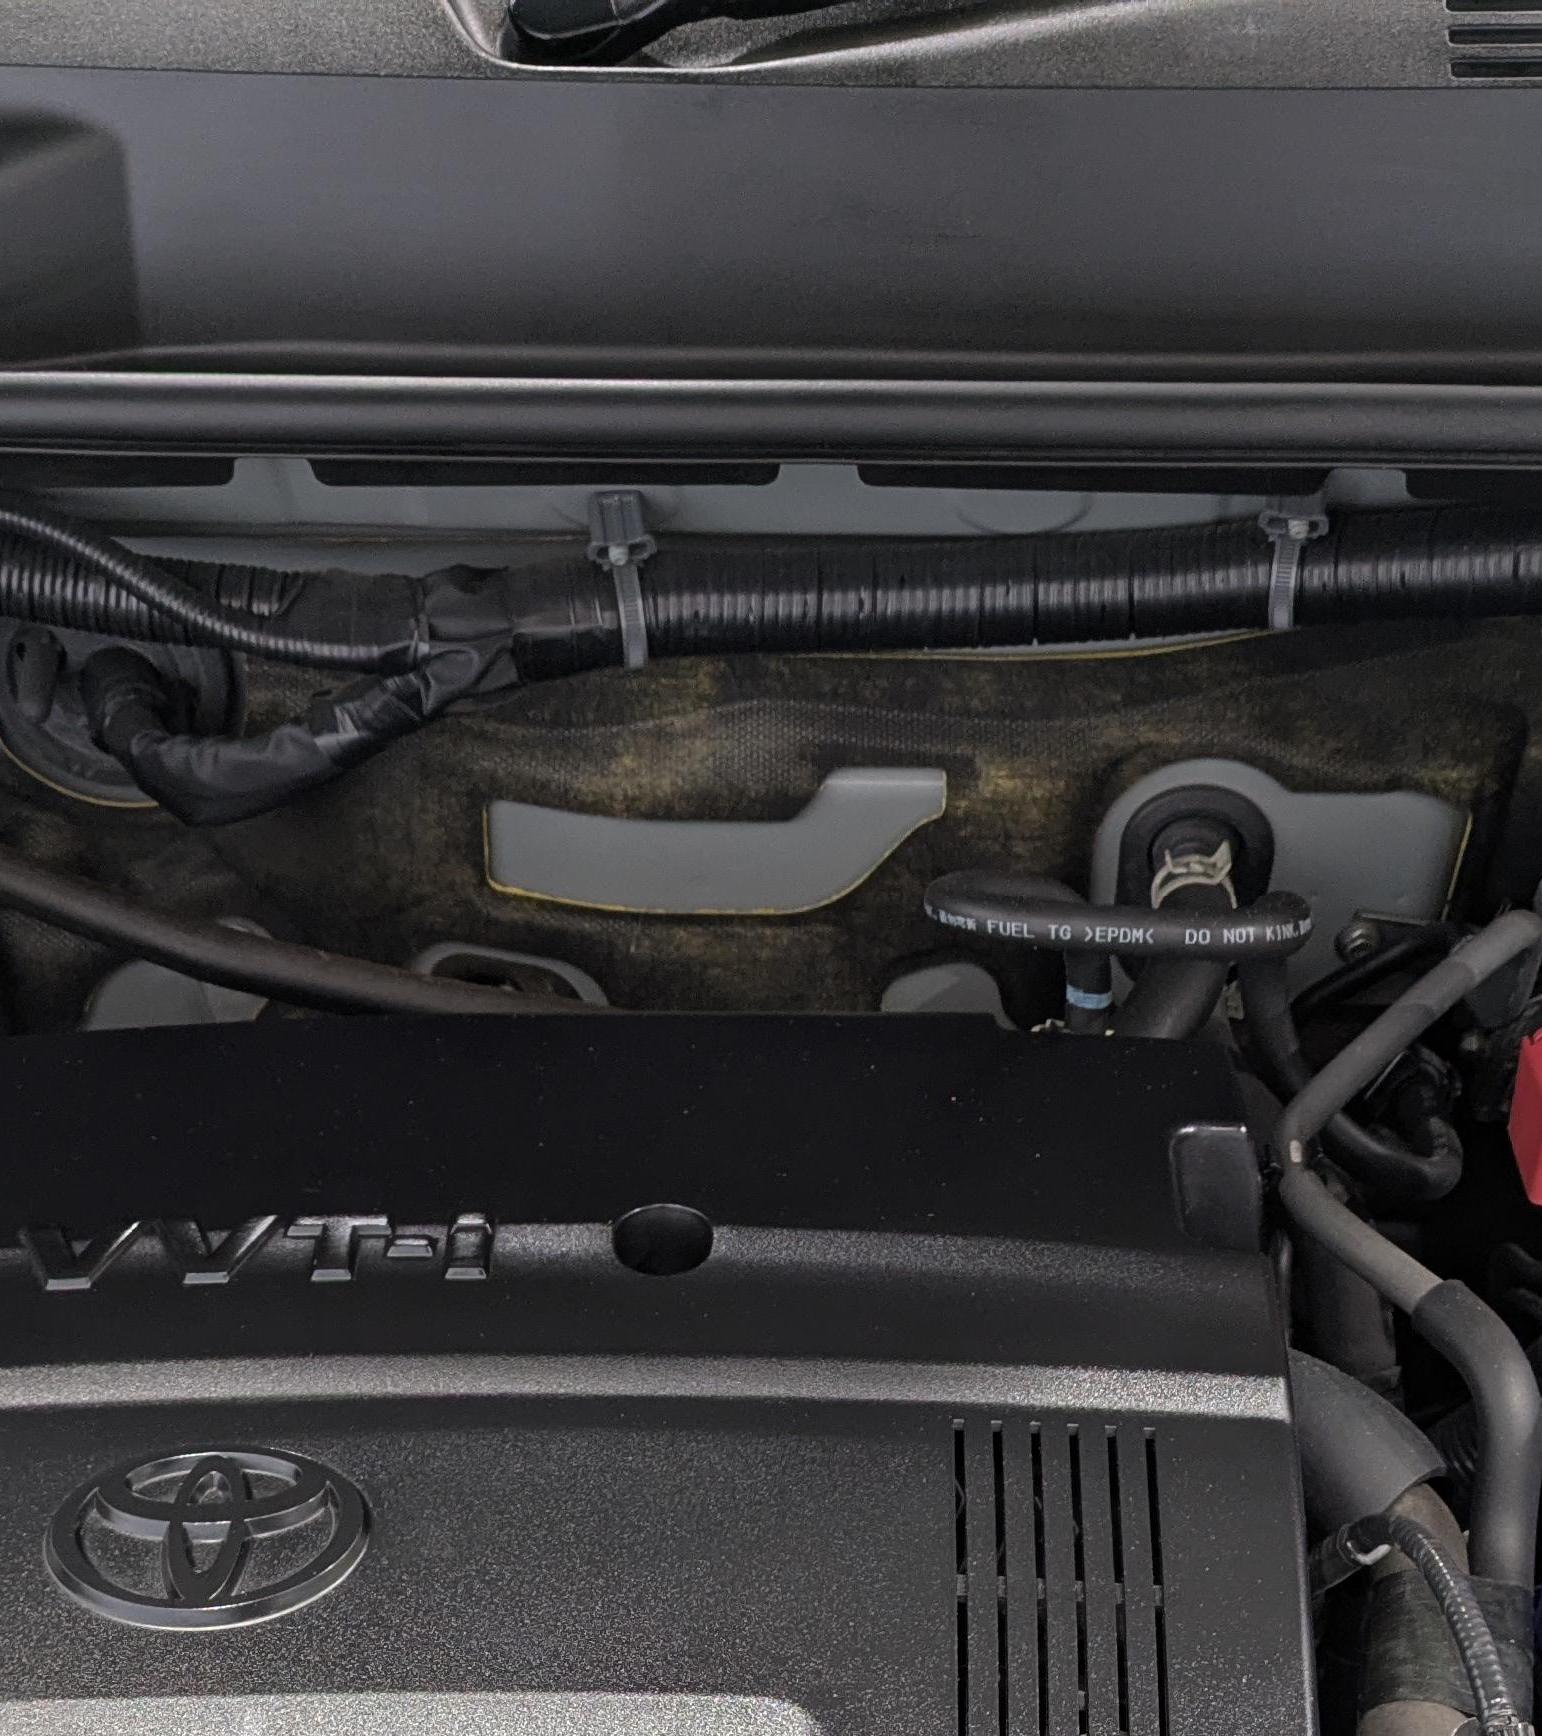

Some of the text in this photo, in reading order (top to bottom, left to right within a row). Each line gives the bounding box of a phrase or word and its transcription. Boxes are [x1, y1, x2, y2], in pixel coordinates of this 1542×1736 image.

[986, 919, 1036, 939] FUEL
[1047, 924, 1072, 941] TG
[1185, 929, 1211, 946] DO
[1222, 926, 1257, 945] NOT
[19, 1212, 495, 1292] VVT-i
